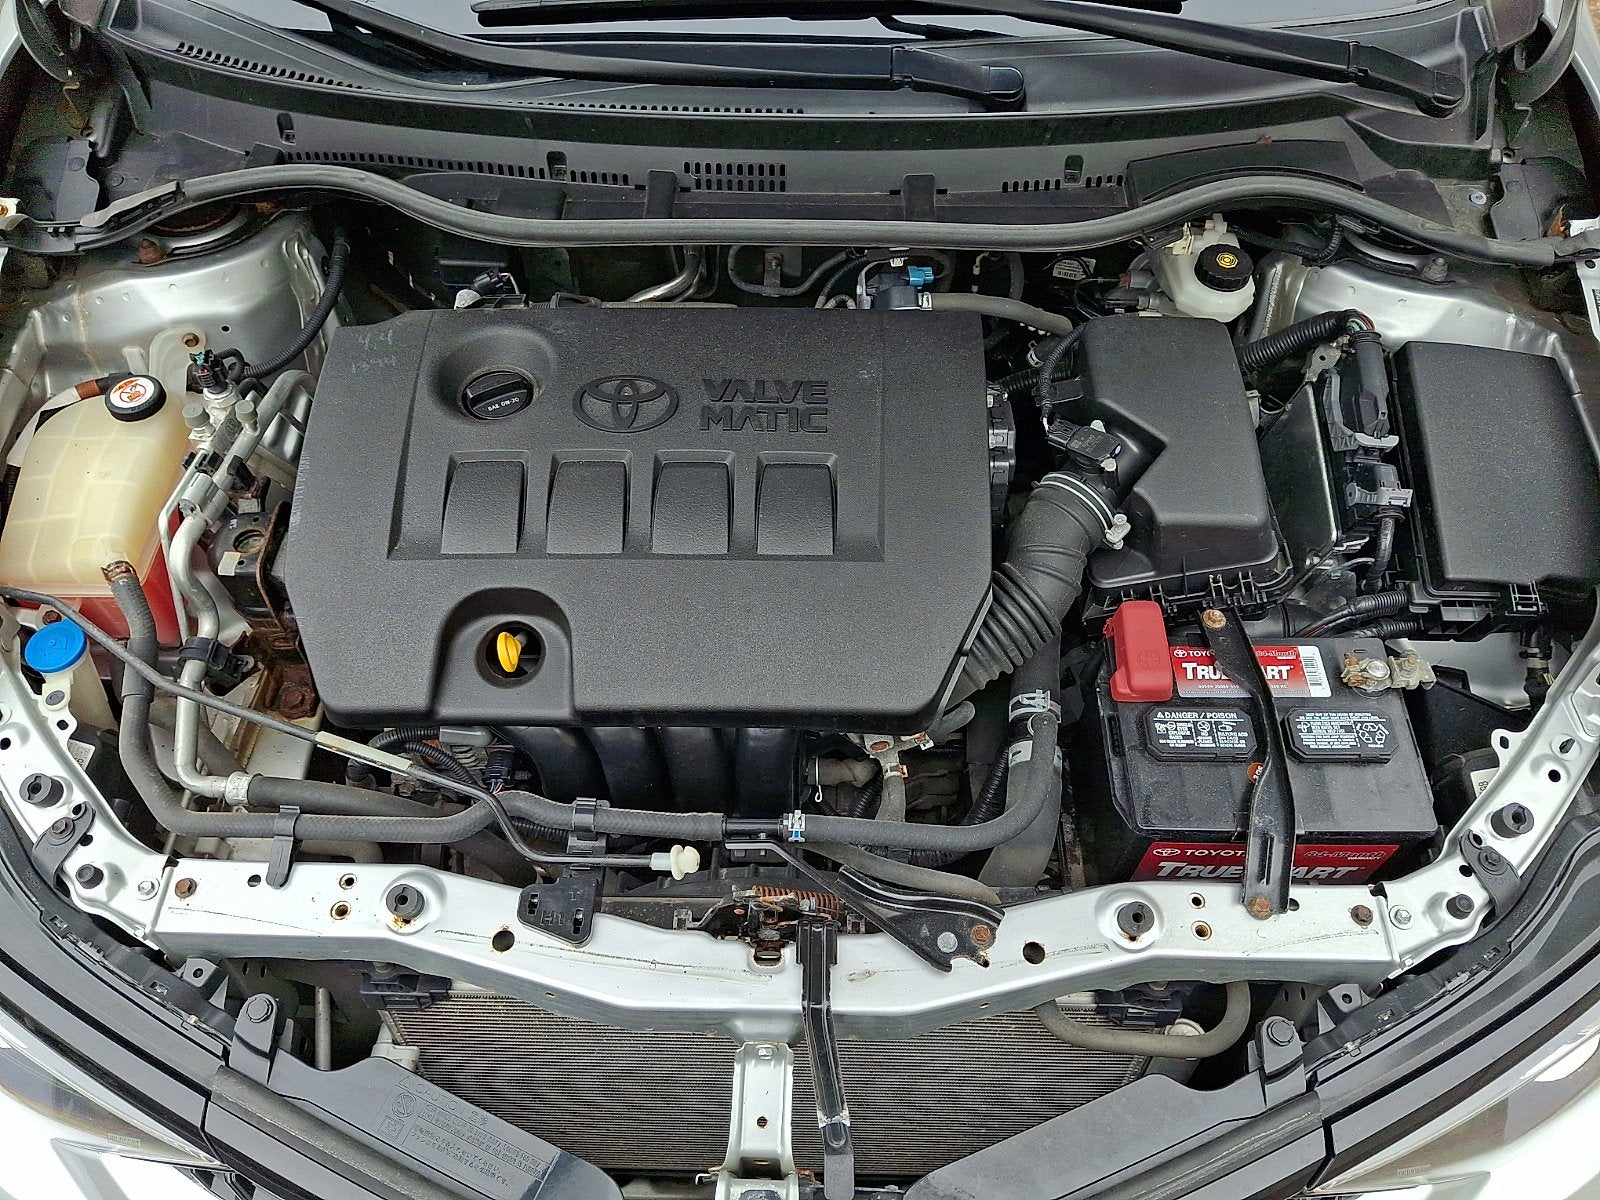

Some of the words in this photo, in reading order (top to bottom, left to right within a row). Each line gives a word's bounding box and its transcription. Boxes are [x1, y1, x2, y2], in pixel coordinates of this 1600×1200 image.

[701, 379, 828, 404] VALVE
[700, 405, 828, 432] MATIC
[1184, 849, 1245, 857] TOYOT
